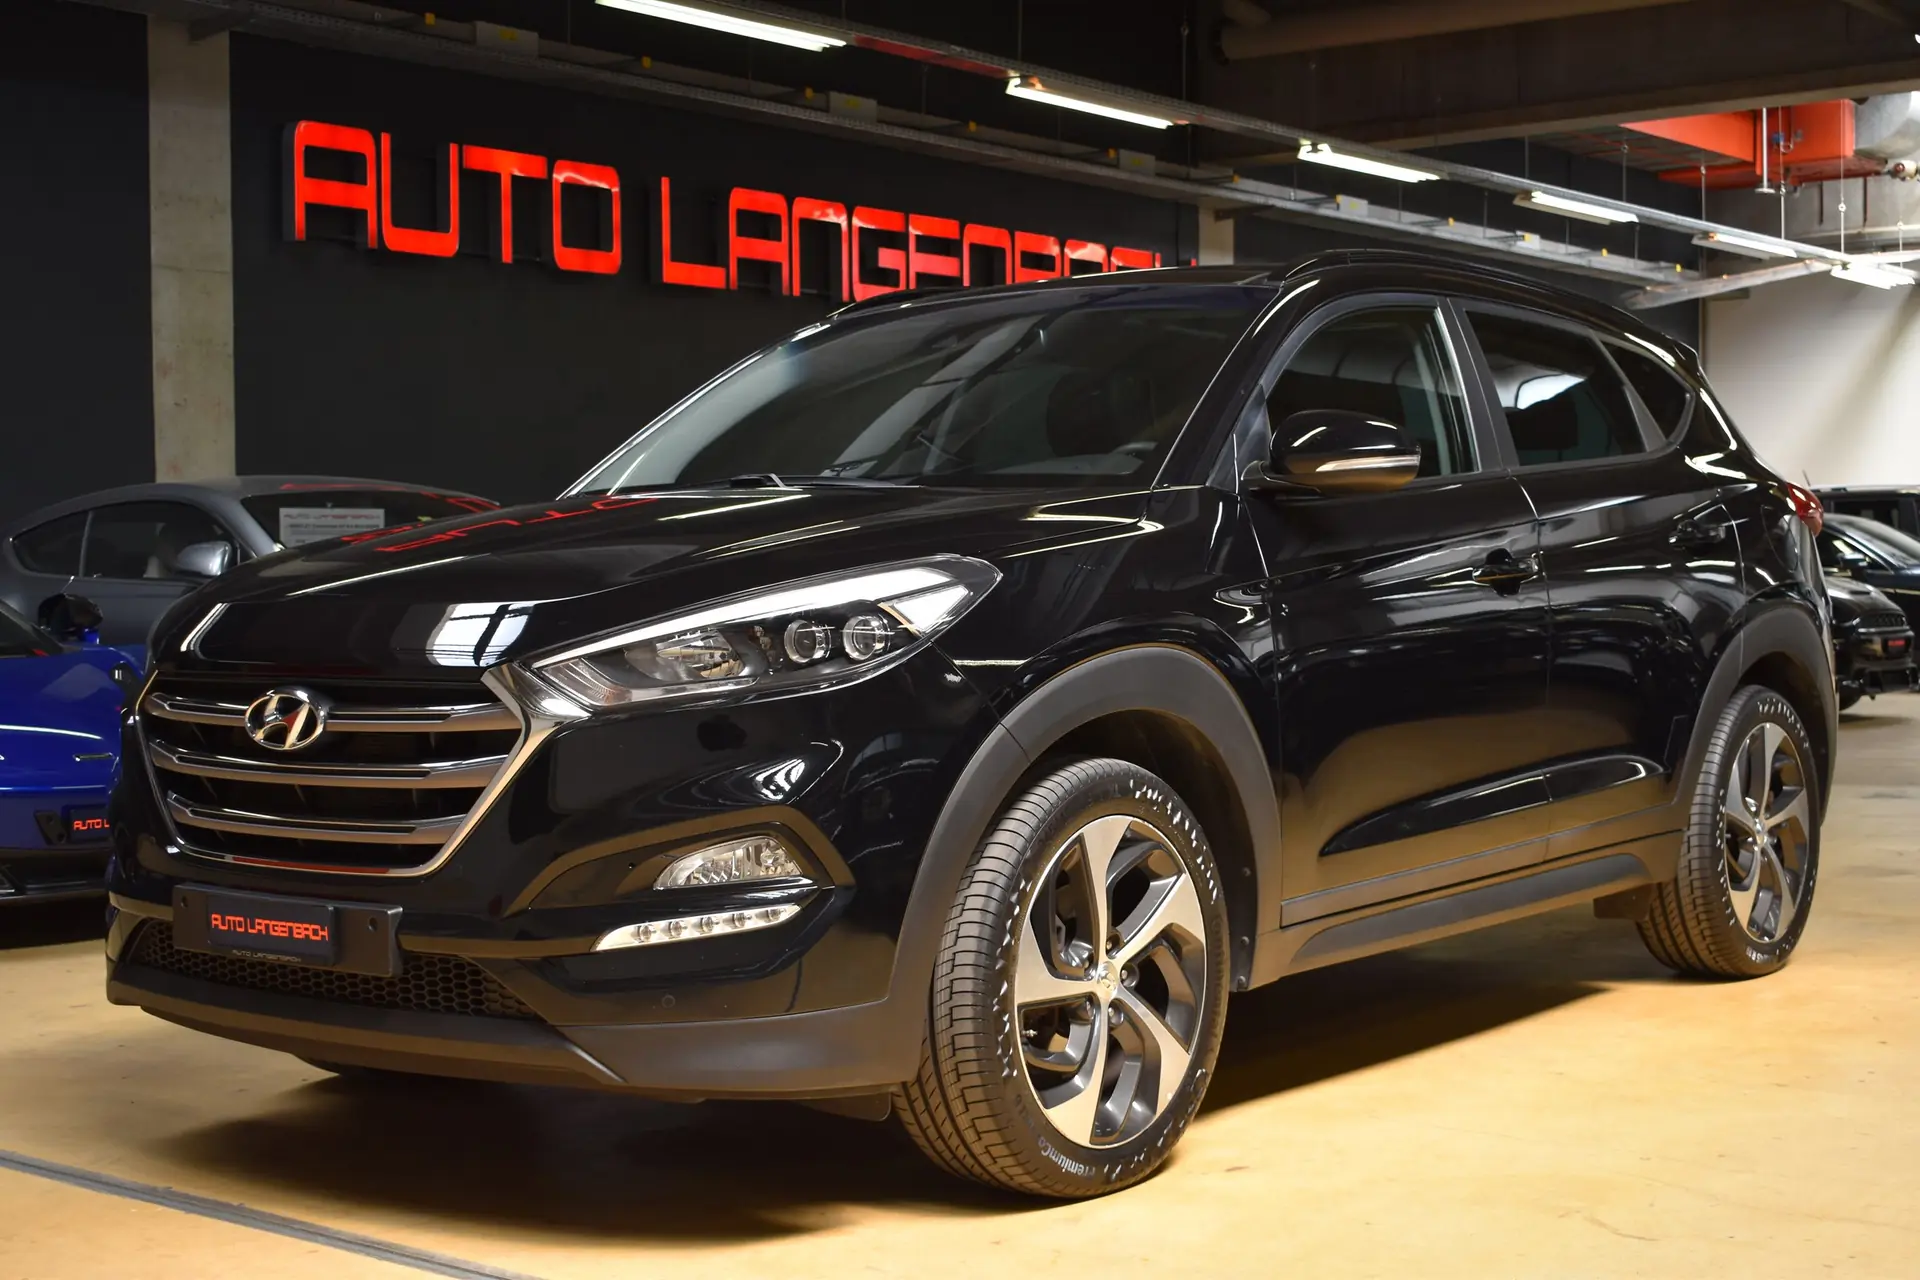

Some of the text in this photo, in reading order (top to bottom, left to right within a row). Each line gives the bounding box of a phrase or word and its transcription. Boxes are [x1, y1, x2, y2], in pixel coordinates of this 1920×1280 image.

[294, 119, 1197, 303] AUTO LANGENB
[73, 818, 103, 831] AUTO
[211, 913, 329, 942] AUTO LANGENBACH
